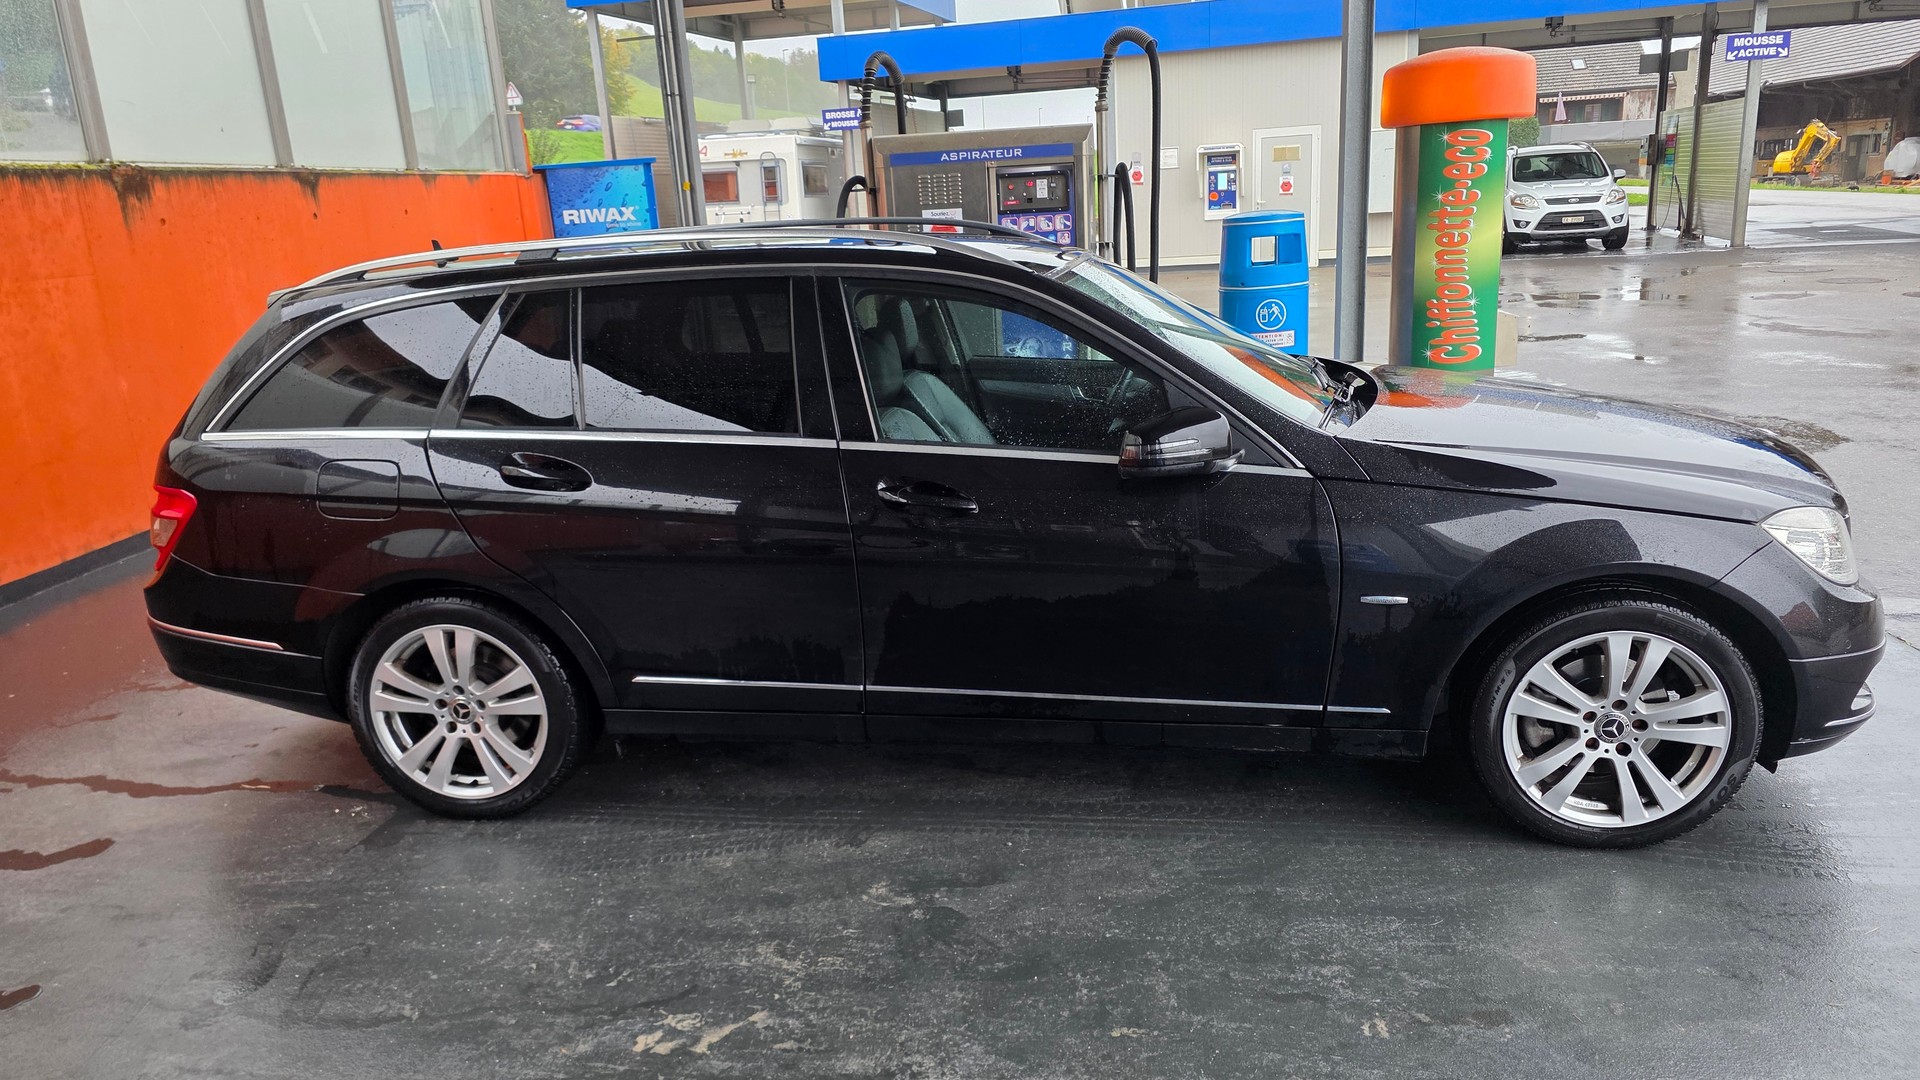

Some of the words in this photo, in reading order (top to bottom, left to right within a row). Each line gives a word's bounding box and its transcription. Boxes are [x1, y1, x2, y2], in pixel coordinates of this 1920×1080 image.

[1734, 35, 1784, 47] MOUSSE
[1738, 47, 1777, 57] ACTIVE
[825, 111, 855, 119] BROSSE
[940, 148, 1022, 161] ASPIRATEUR
[562, 206, 636, 224] RIWAX
